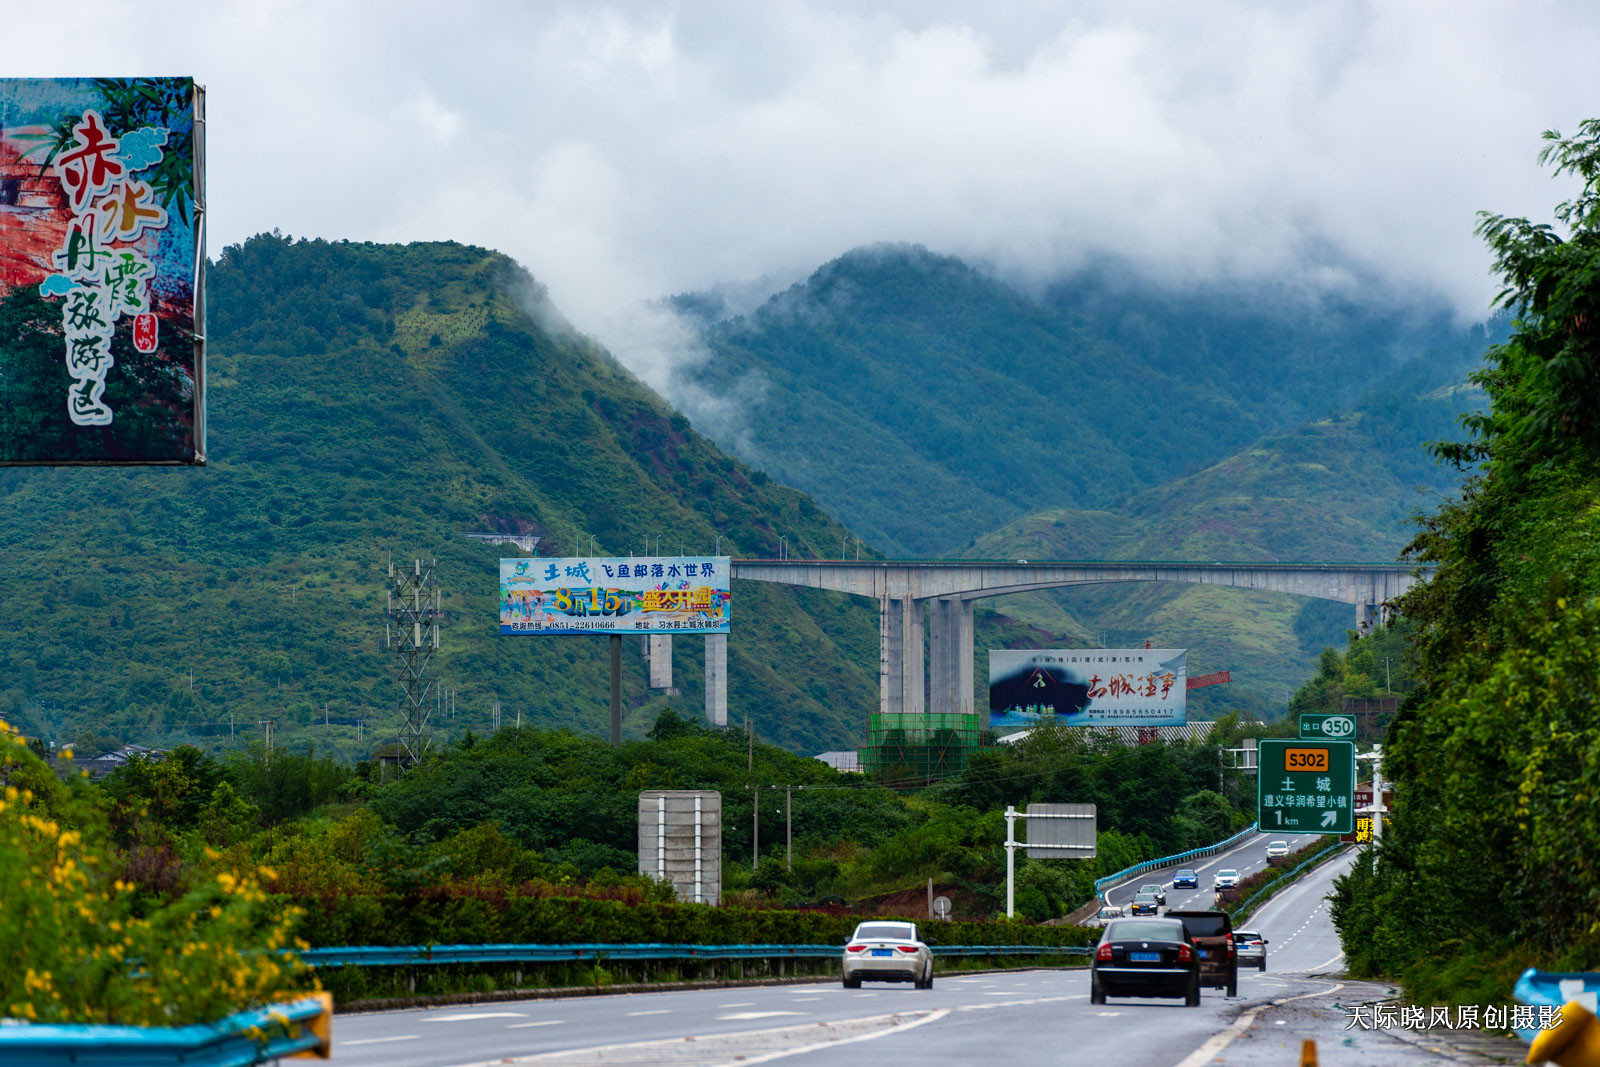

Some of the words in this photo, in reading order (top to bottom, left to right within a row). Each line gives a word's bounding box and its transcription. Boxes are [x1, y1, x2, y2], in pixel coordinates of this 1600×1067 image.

[544, 561, 593, 584] 土城
[601, 562, 716, 578] 飞鱼部落水世界
[1302, 722, 1320, 731] 出口
[1325, 720, 1351, 734] 350
[1289, 753, 1325, 767] S302
[1281, 776, 1331, 792] 土城
[1264, 794, 1347, 808] 遵义华润希望小镇
